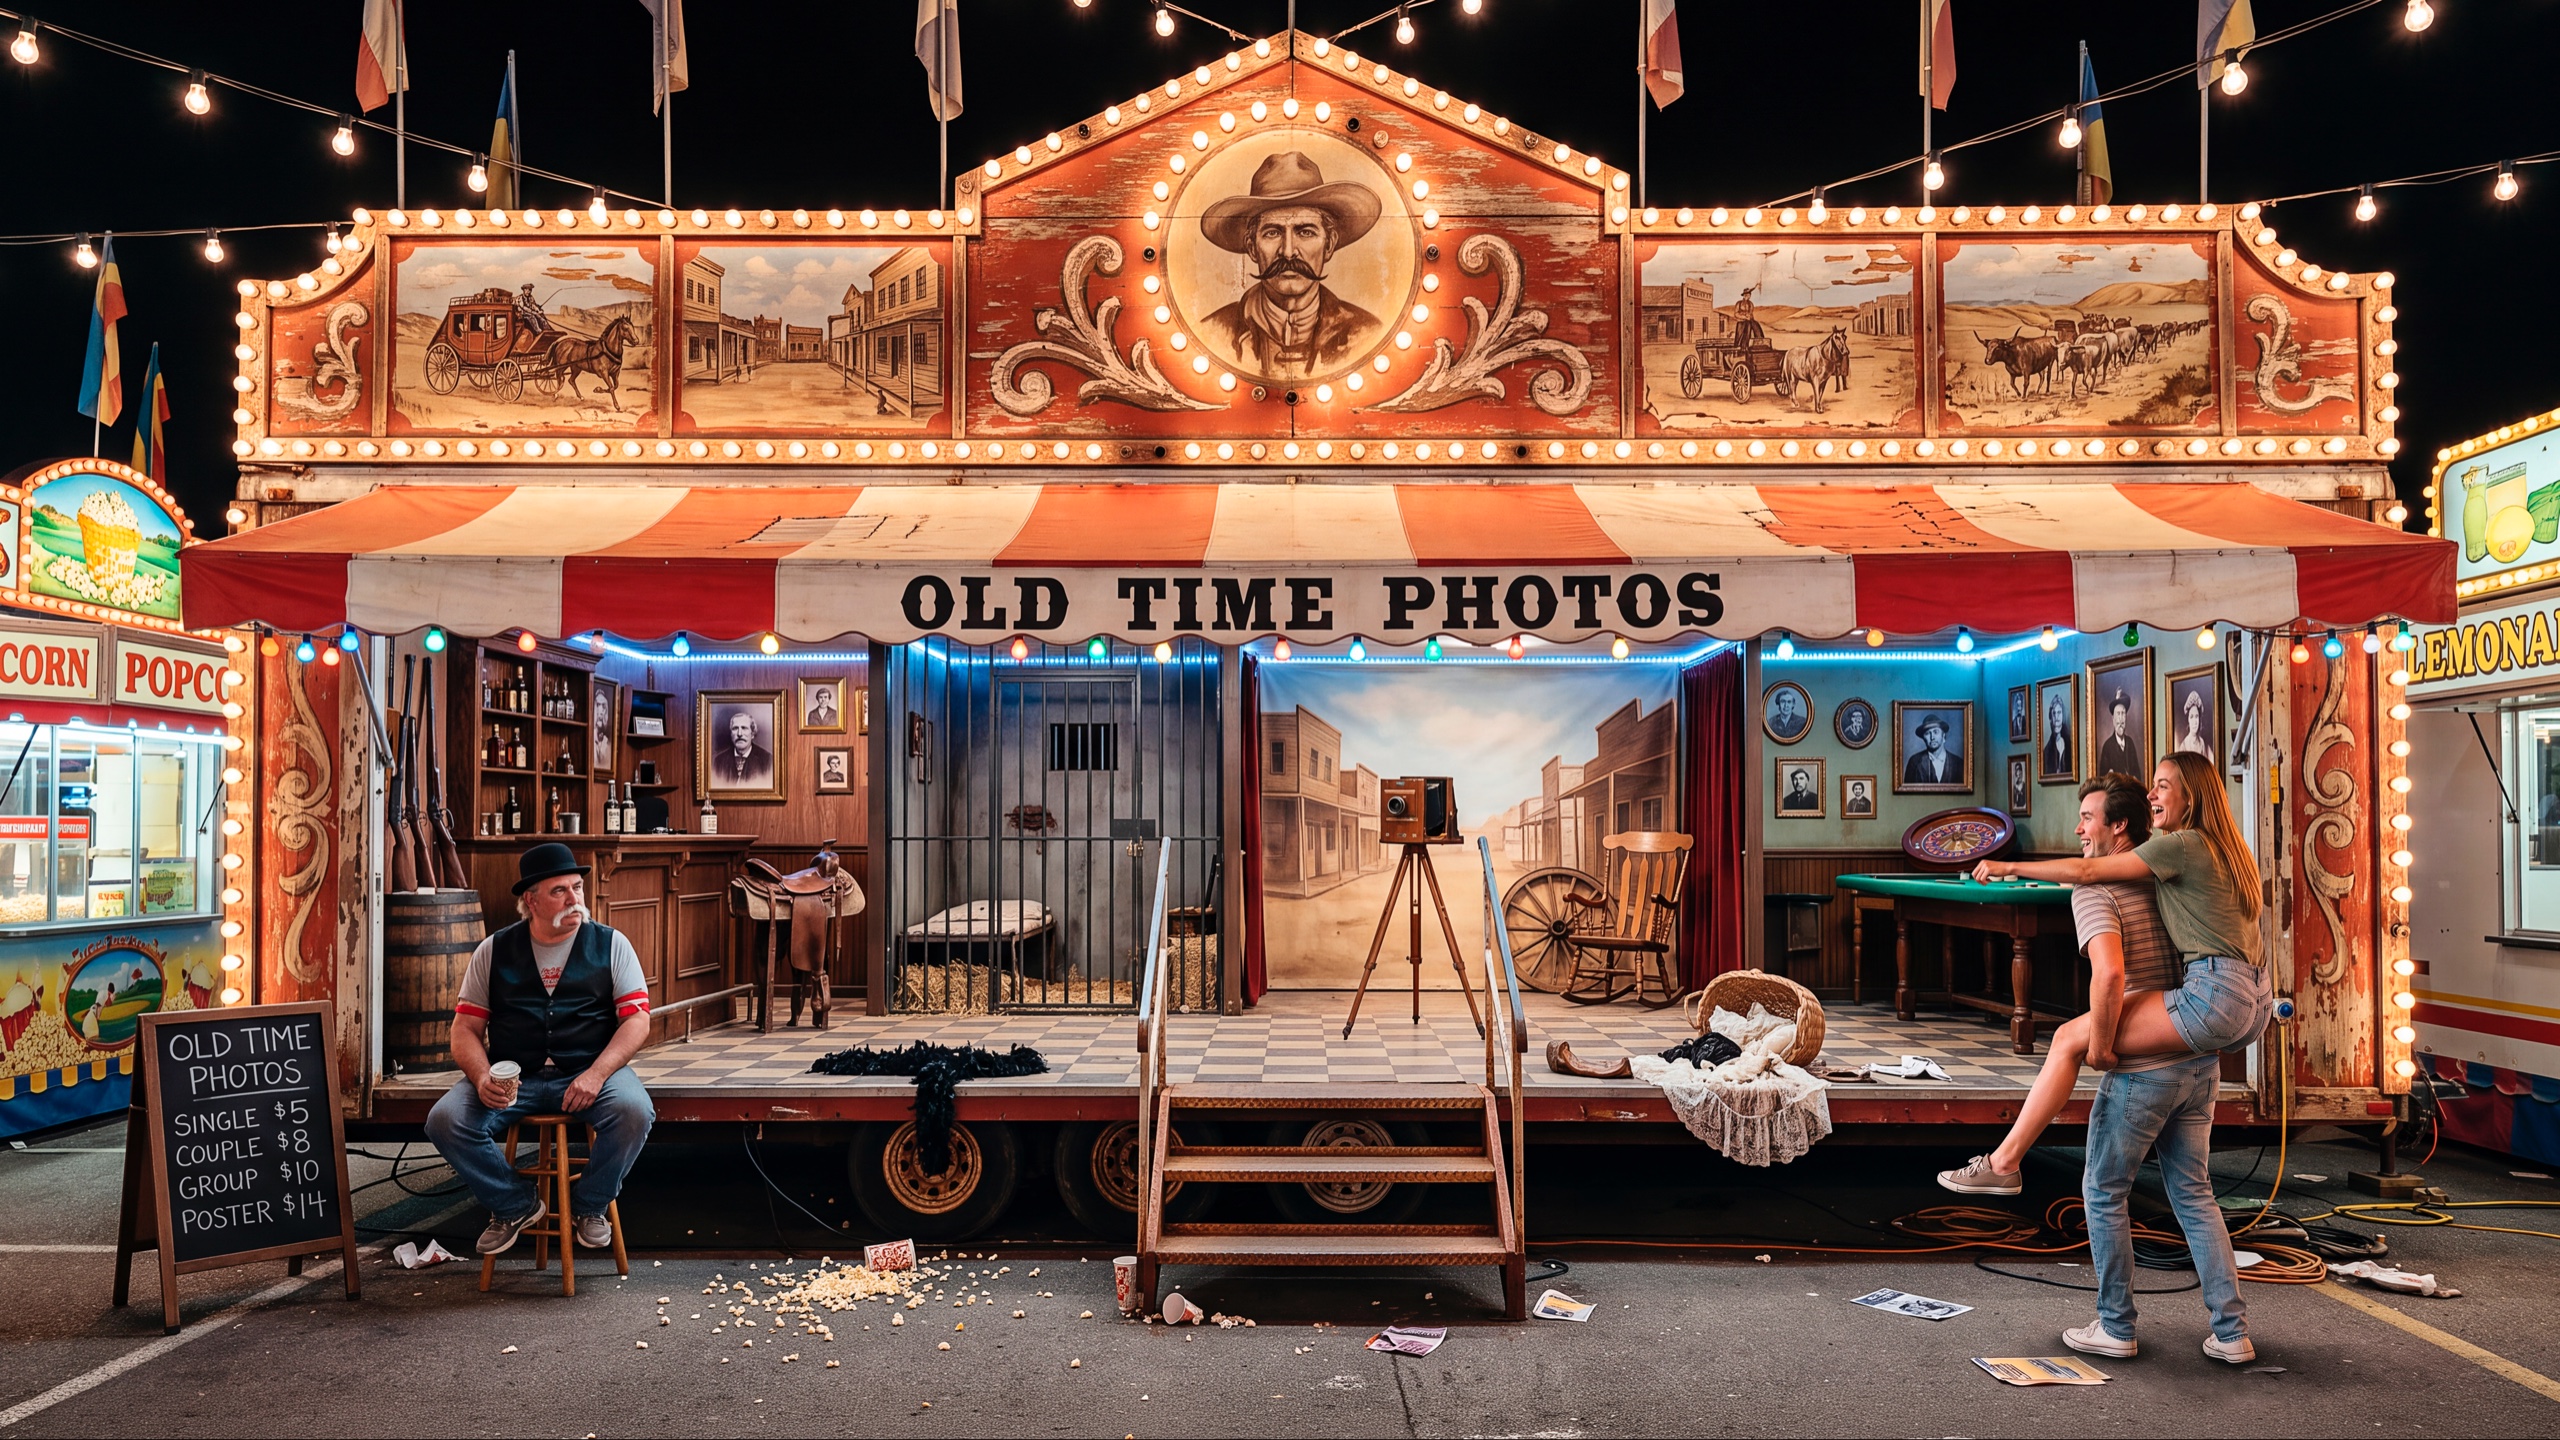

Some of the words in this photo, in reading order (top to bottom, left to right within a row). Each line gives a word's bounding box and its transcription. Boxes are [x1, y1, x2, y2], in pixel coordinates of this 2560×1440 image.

[900, 574, 1070, 631] OLD
[1117, 577, 1333, 631] TIME
[1382, 571, 1725, 631] PHOTOS
[0, 642, 90, 689] CORN
[2406, 608, 2560, 685] LEMONA
[169, 1031, 232, 1061] OLD
[239, 1023, 312, 1055] TIME
[189, 1058, 302, 1095] PHOTOS
[174, 1107, 261, 1137] SINGLE
[273, 1098, 309, 1125] $5
[175, 1136, 264, 1167] COUPLE
[277, 1128, 311, 1154] $8
[178, 1168, 259, 1200] GROUP
[279, 1159, 320, 1185] $10
[181, 1200, 274, 1234] POSTER
[282, 1190, 327, 1220] $14
